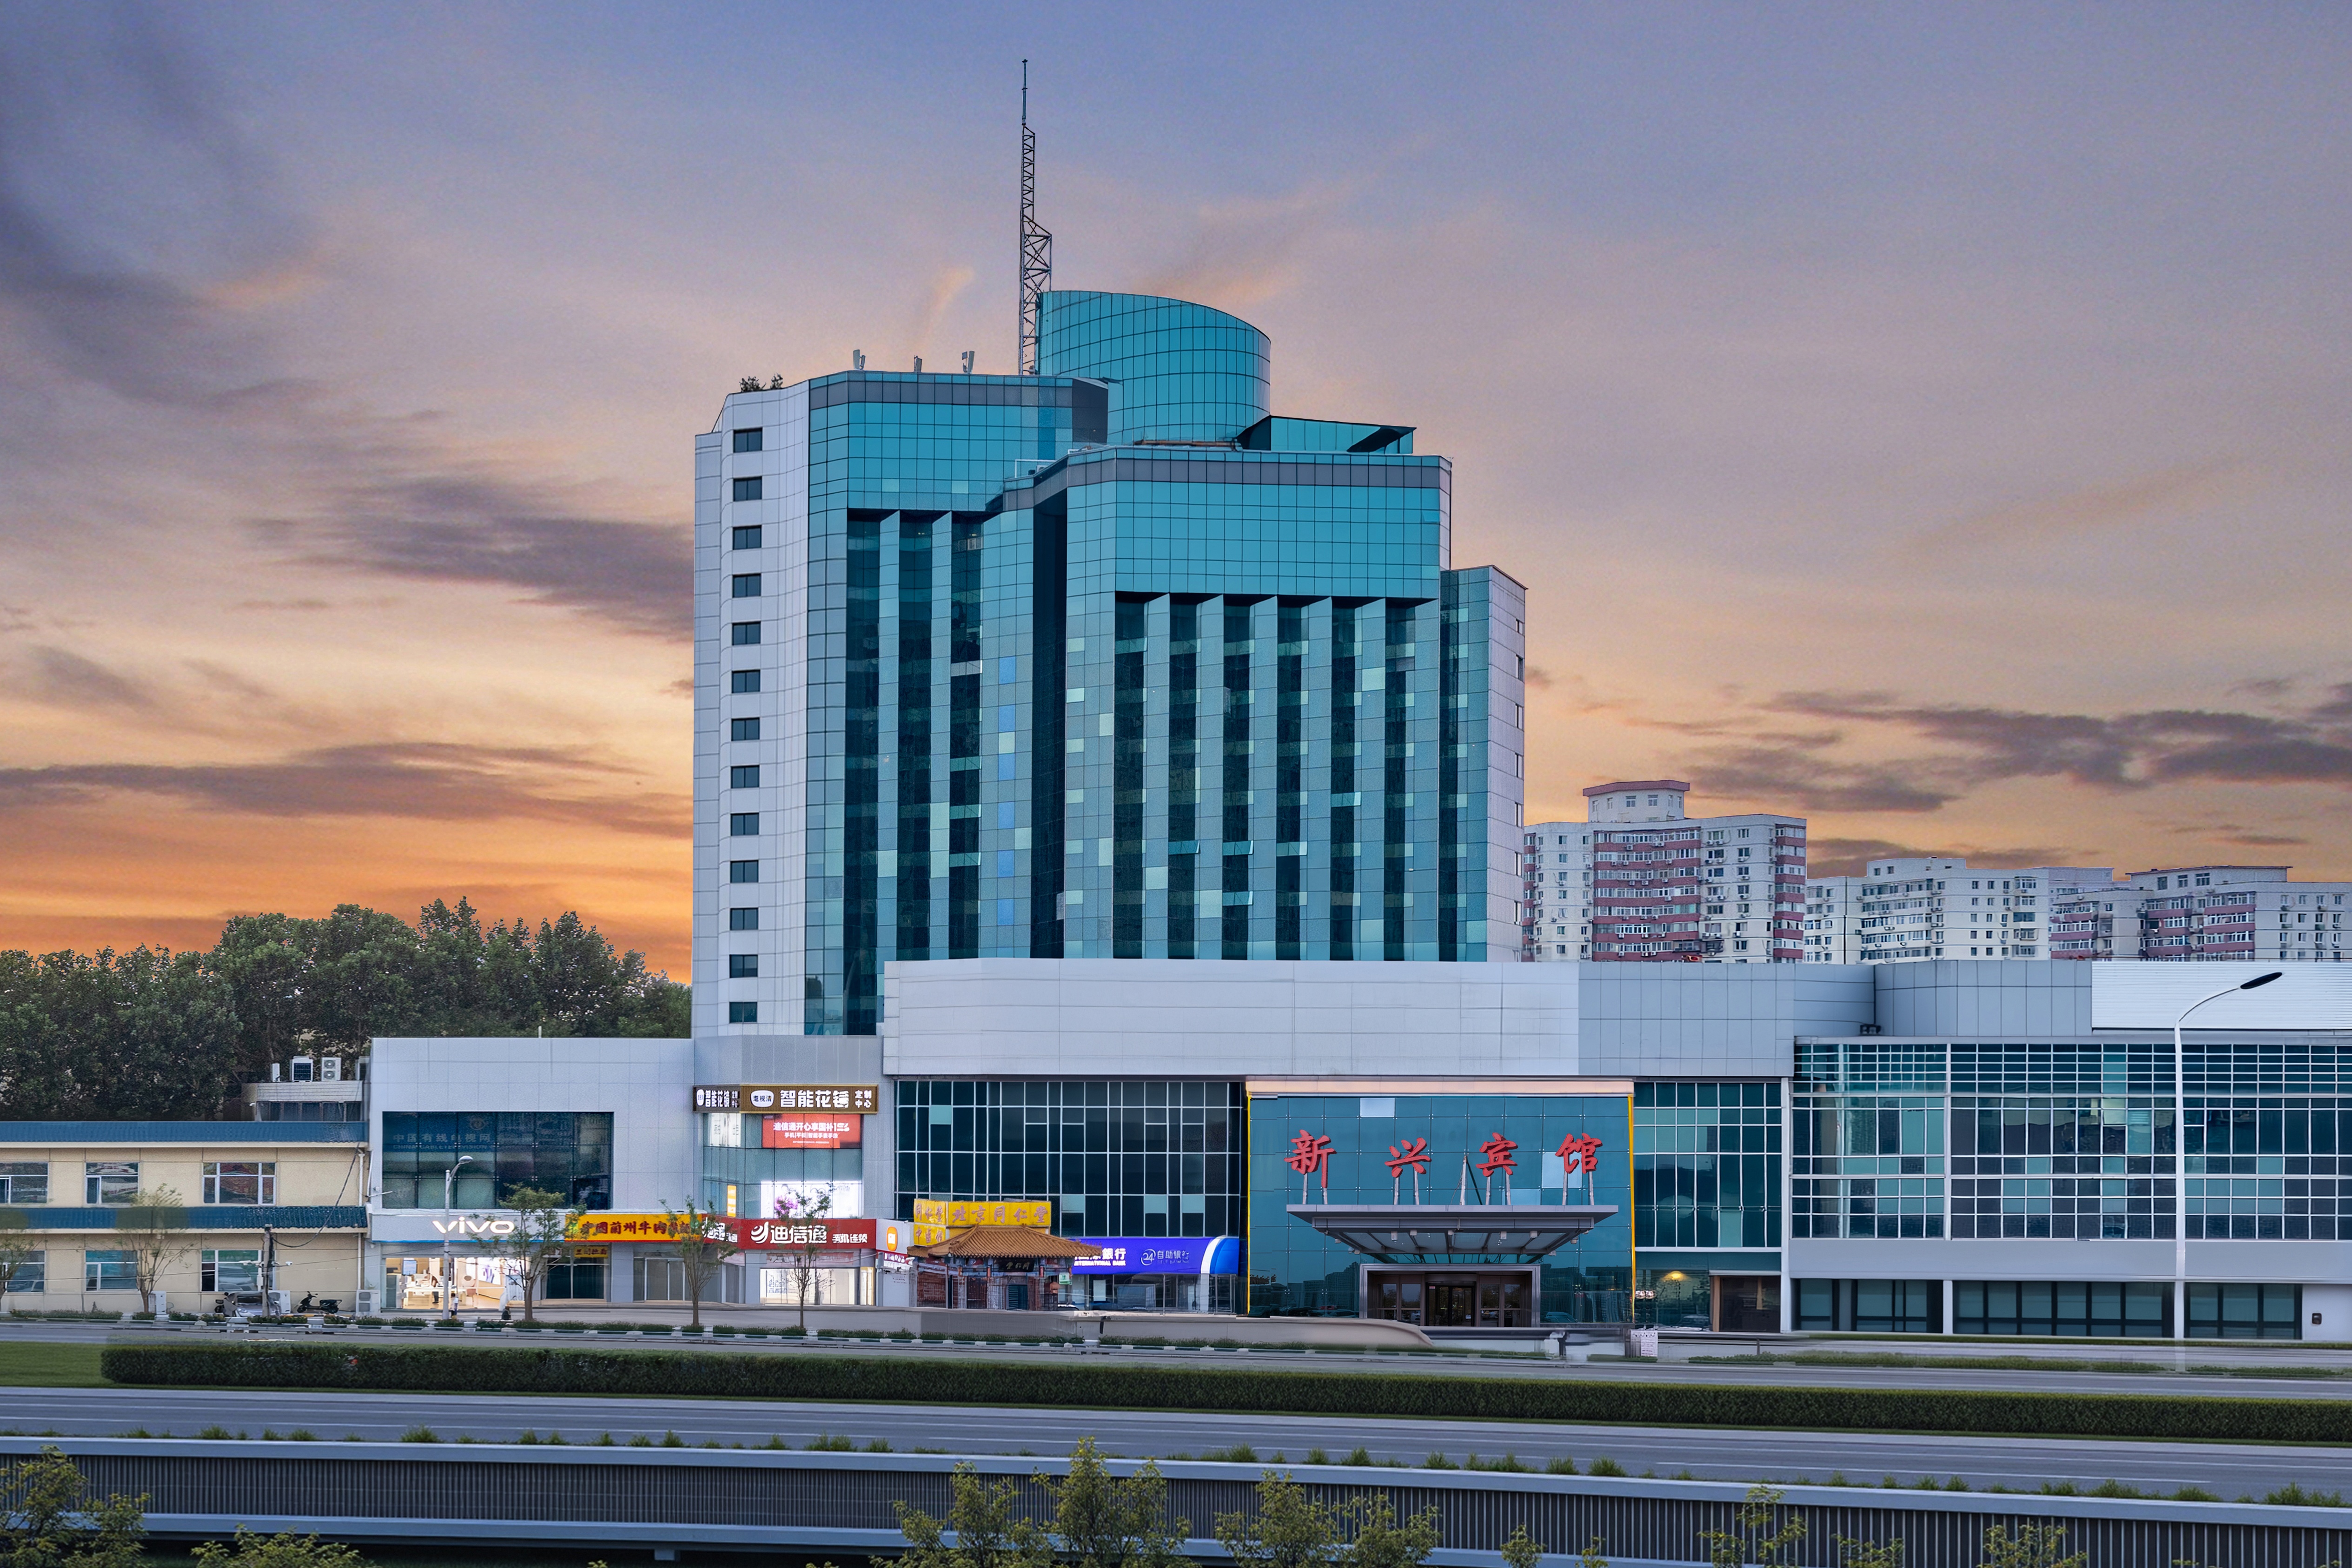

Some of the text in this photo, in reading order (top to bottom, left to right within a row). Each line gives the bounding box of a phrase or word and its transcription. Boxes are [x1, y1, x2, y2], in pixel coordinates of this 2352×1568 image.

[855, 1090, 872, 1099] 定制
[855, 1099, 872, 1108] 中心
[1284, 1129, 1603, 1189] 新兴宾馆
[952, 1205, 1048, 1224] 北京同仁堂
[432, 1216, 515, 1234] vivo
[770, 1225, 827, 1244] 迪信通
